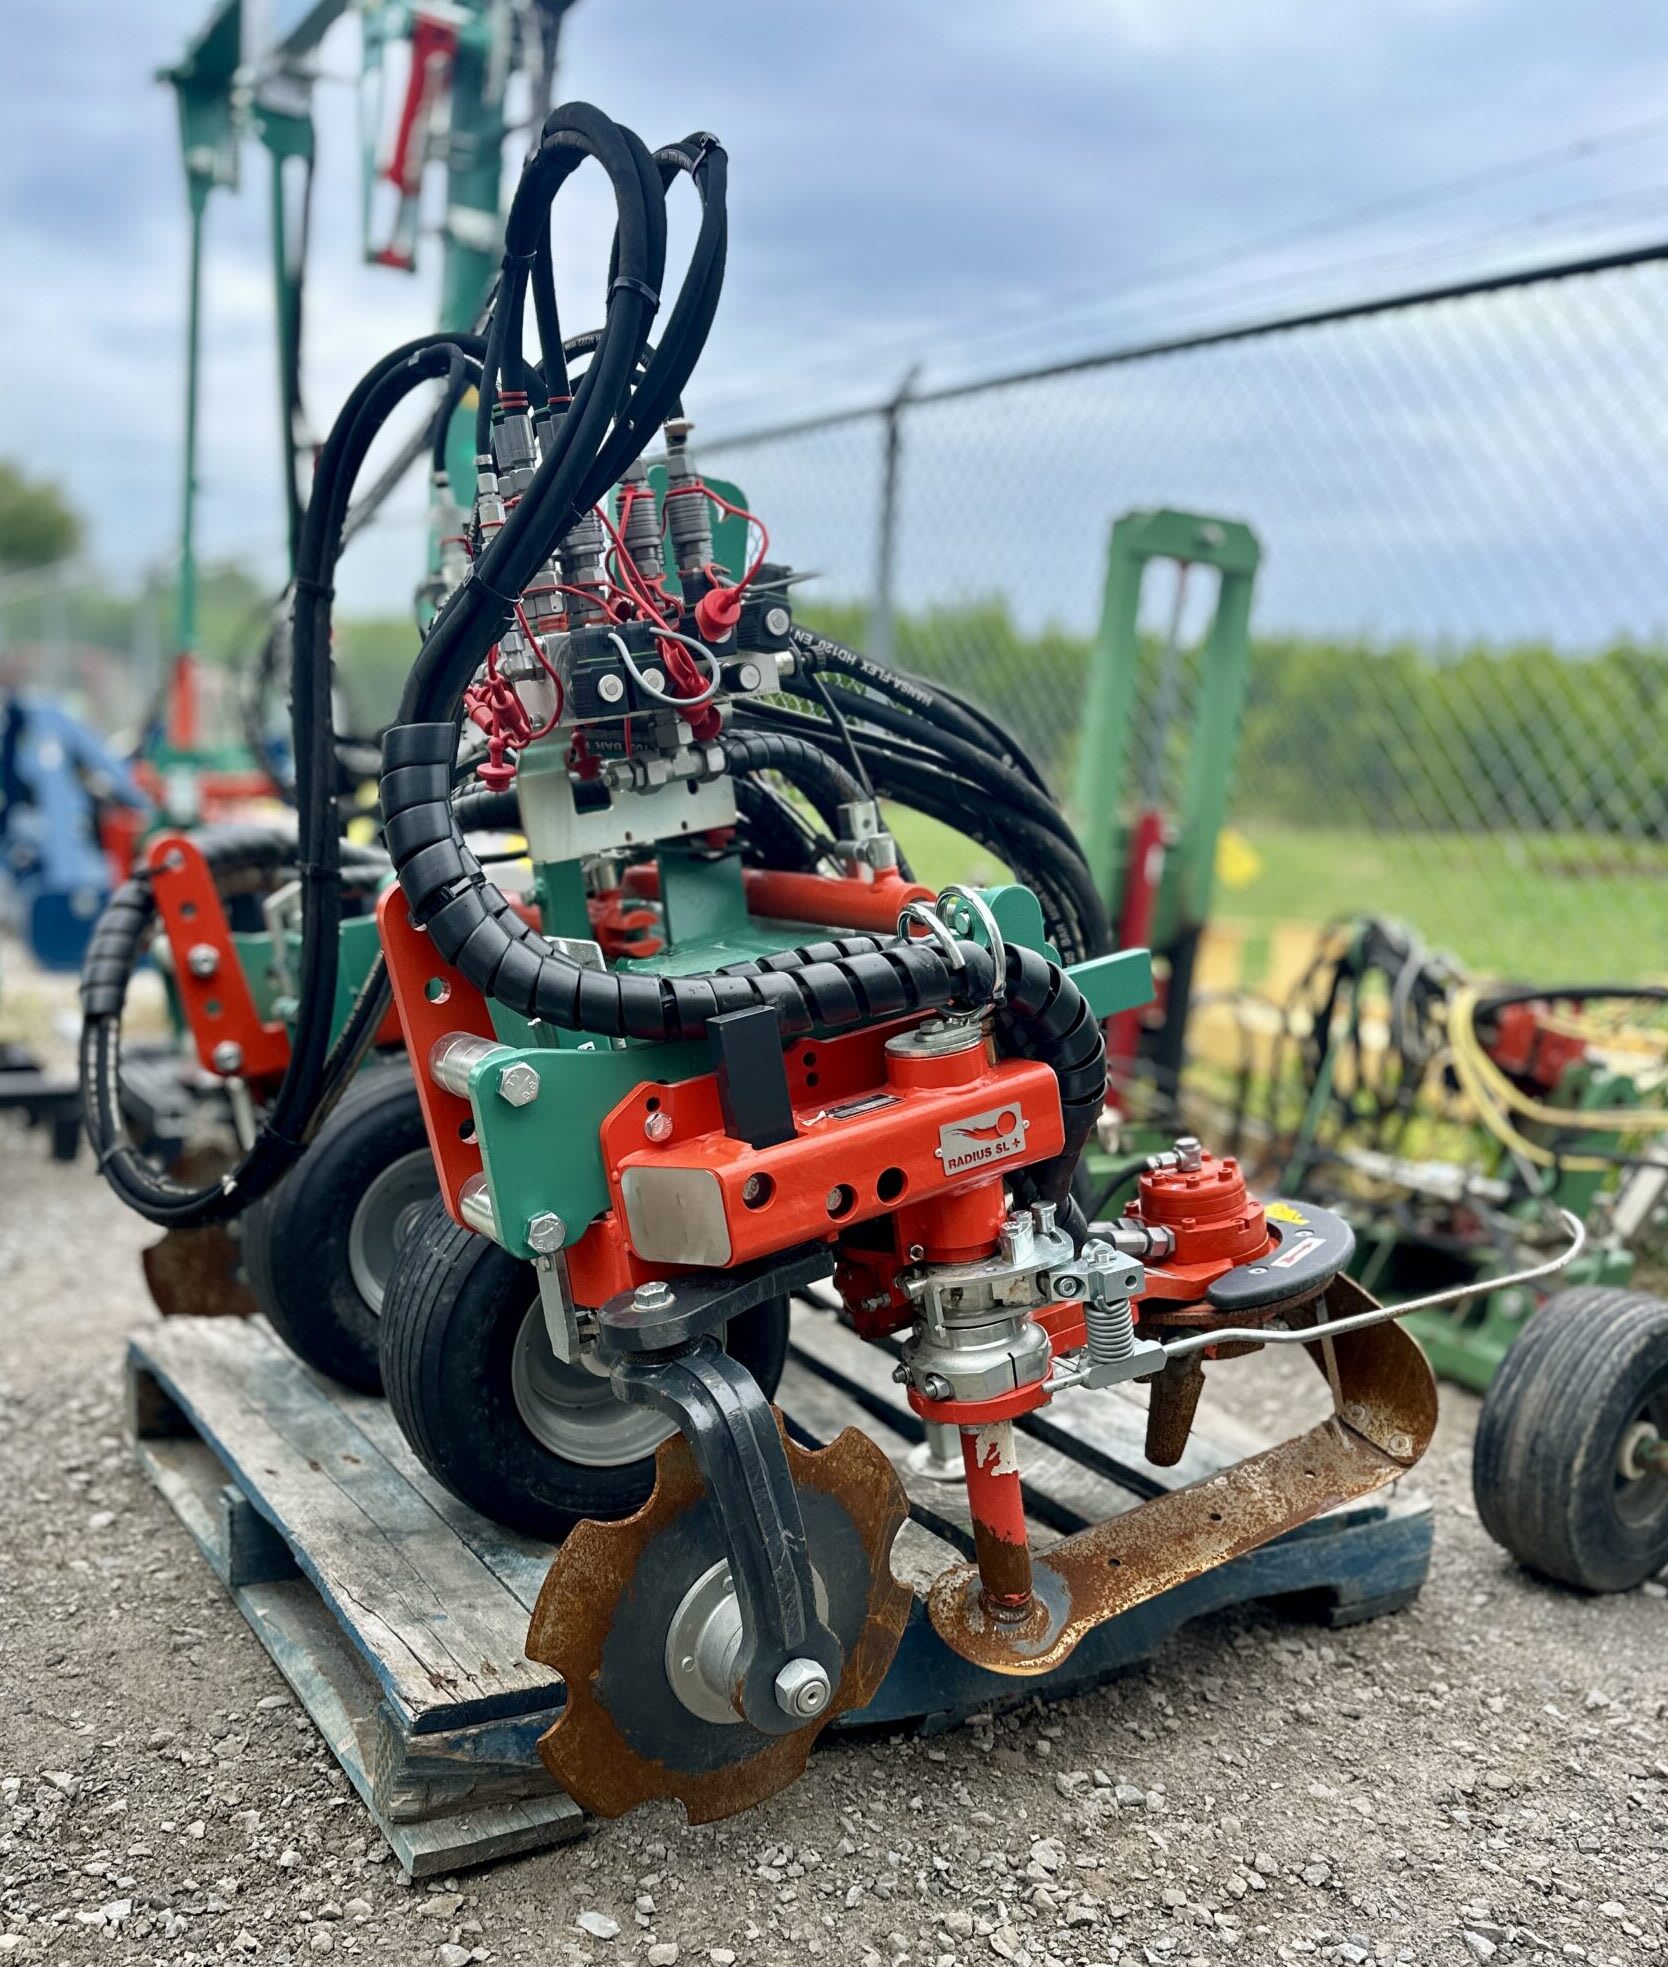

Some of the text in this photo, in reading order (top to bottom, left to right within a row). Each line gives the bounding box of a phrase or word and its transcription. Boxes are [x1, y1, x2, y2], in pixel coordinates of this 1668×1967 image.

[794, 629, 933, 708] HANSA-FLEX HD120 EN
[948, 1147, 992, 1169] RADIUS
[995, 1141, 1010, 1154] SL
